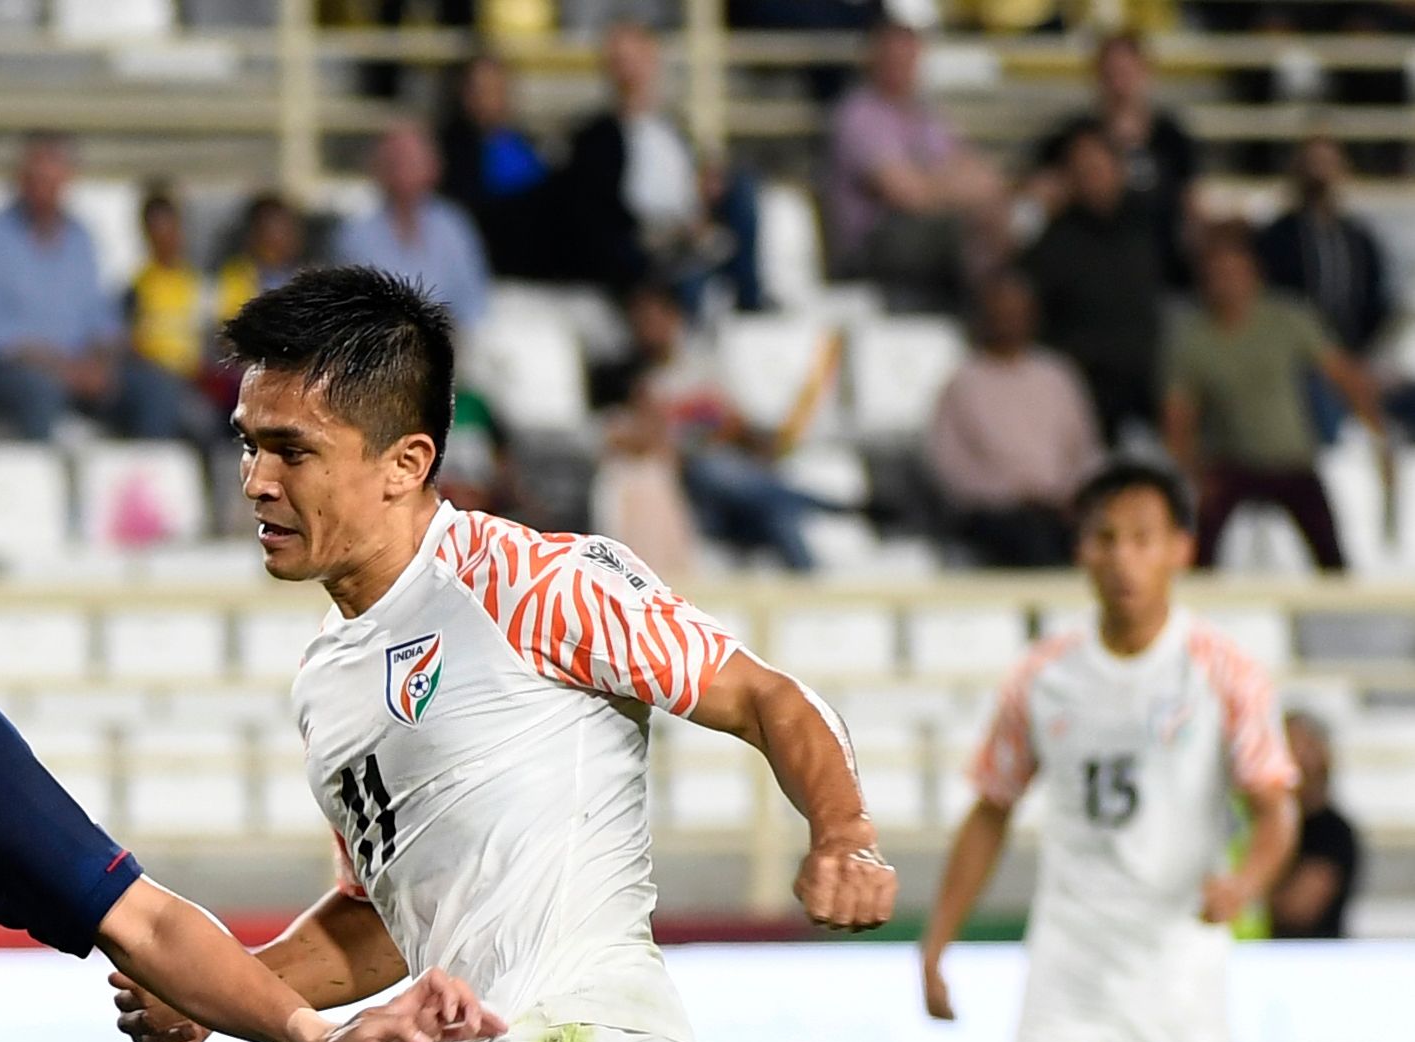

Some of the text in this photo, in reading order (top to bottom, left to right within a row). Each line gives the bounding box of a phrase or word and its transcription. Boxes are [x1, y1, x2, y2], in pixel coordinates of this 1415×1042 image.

[393, 645, 424, 664] INDIA
[340, 753, 397, 880] 11
[1082, 754, 1140, 828] 15
